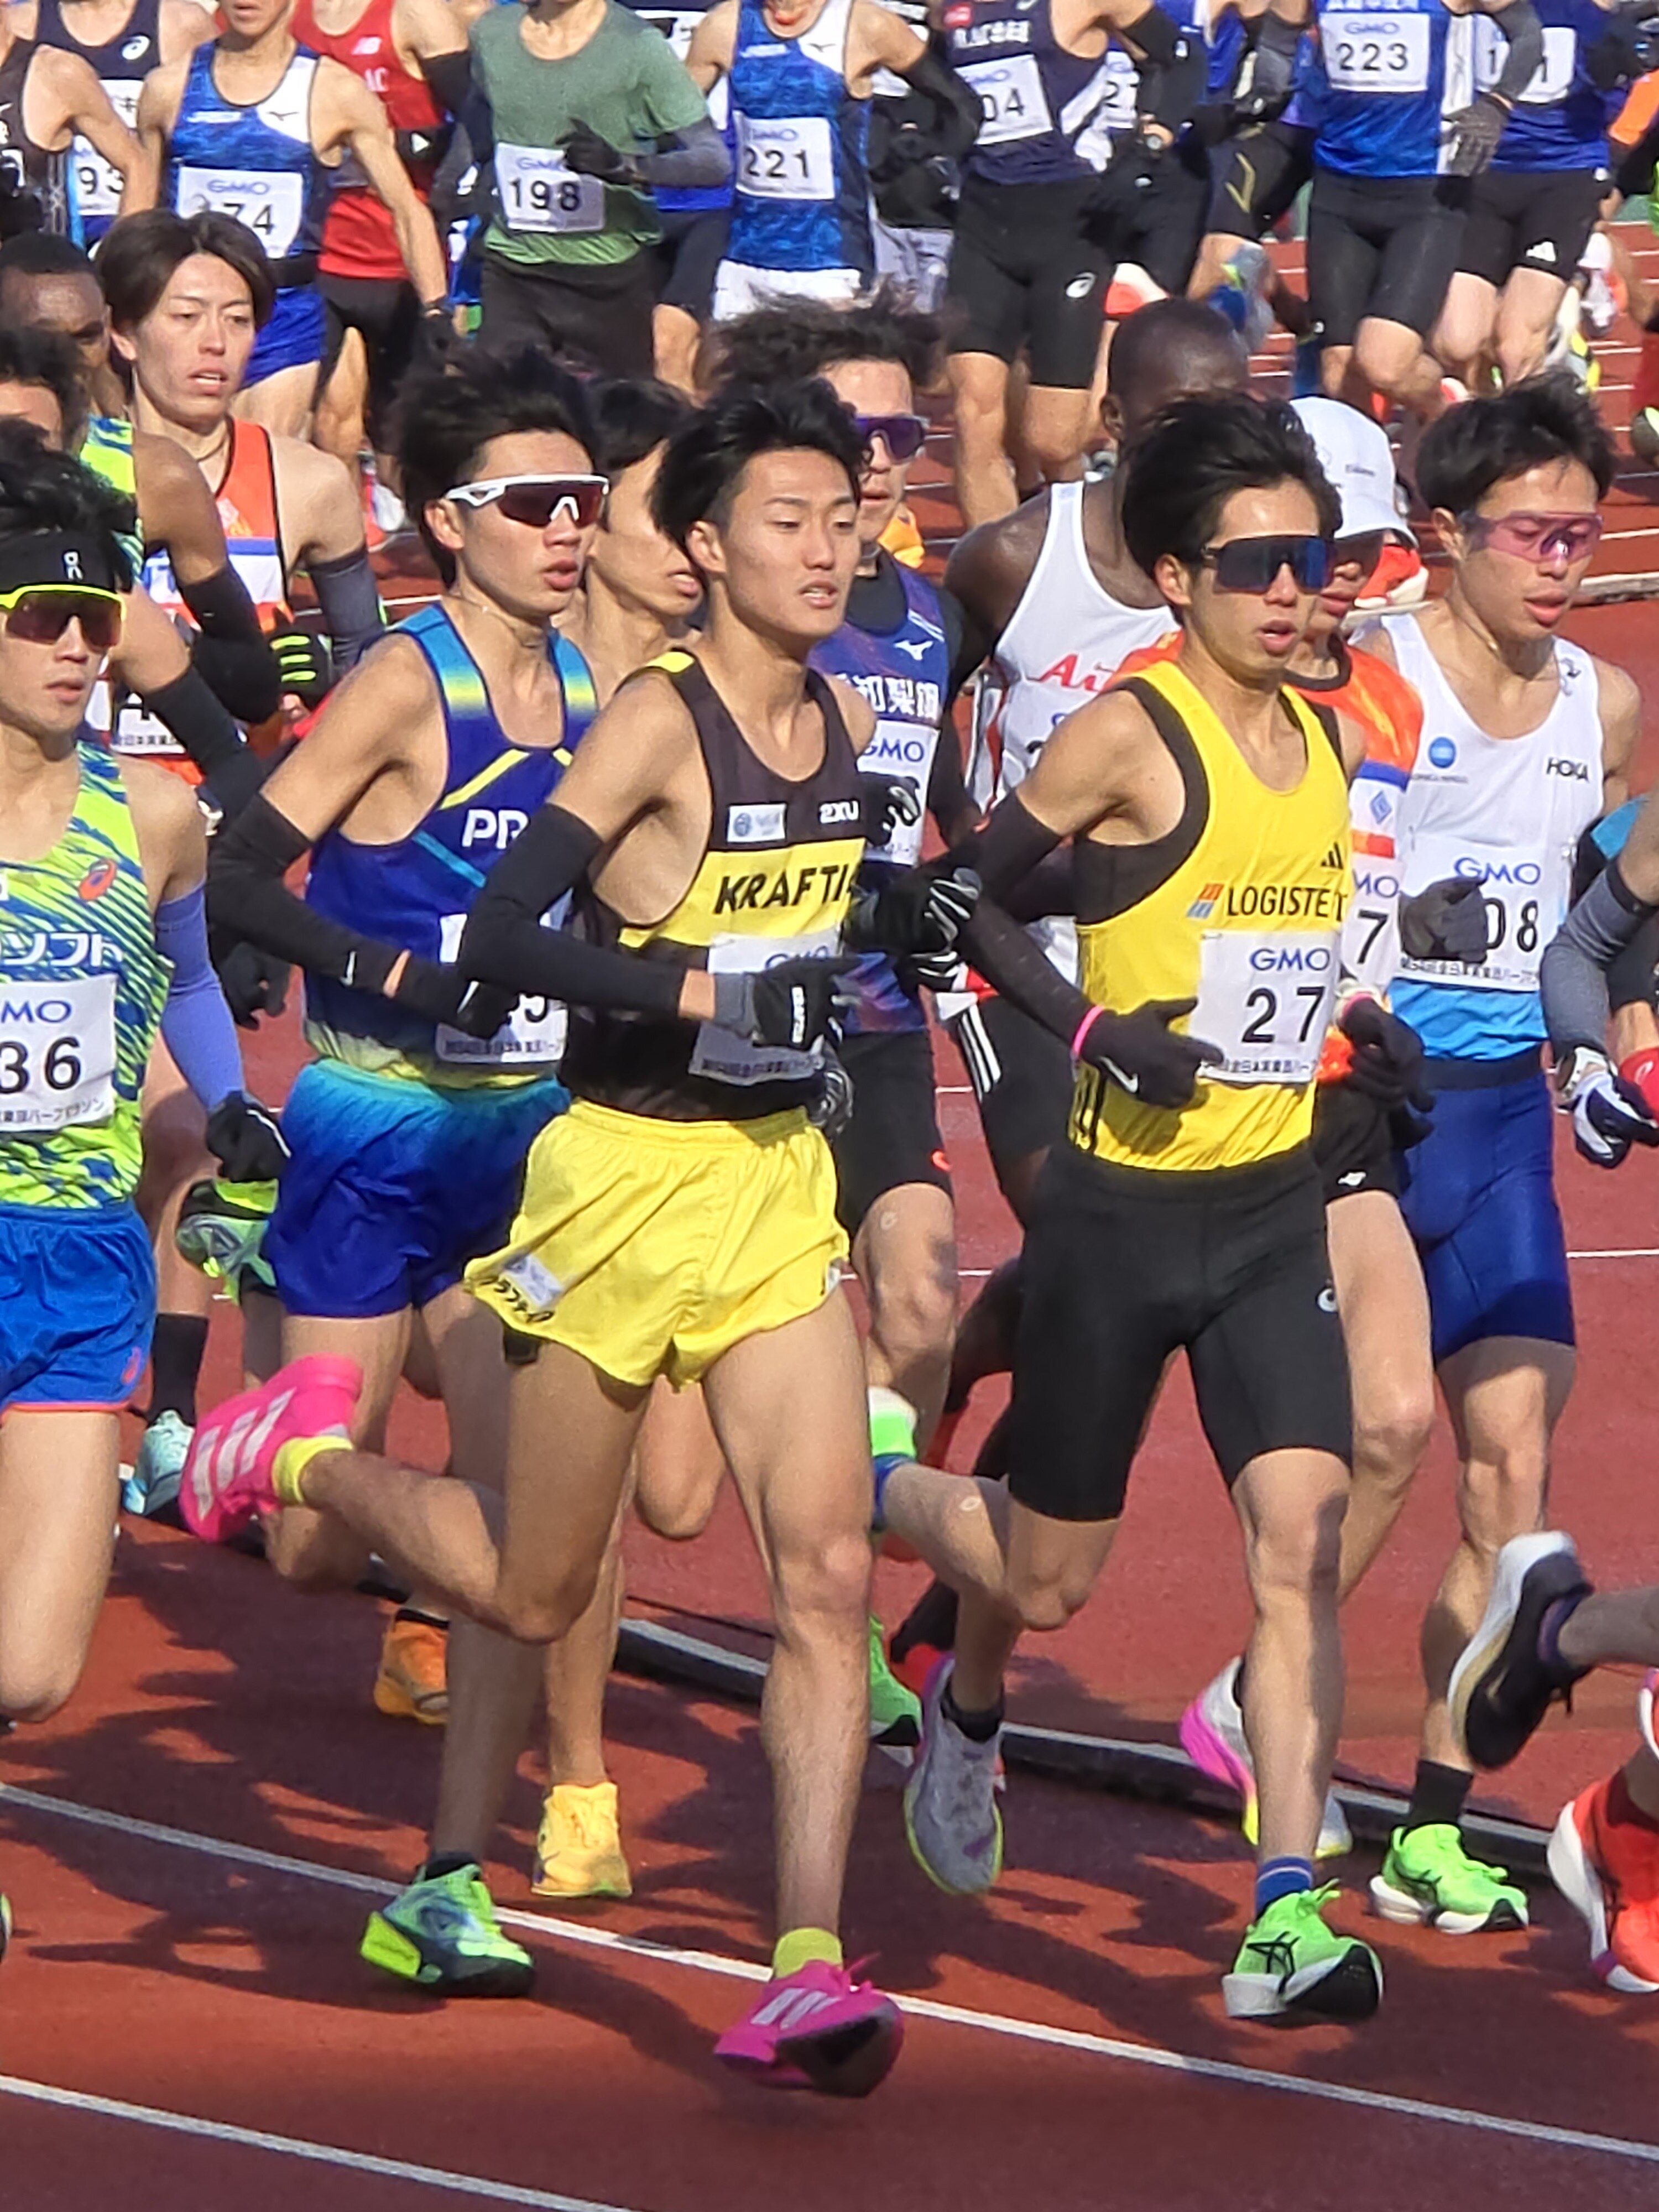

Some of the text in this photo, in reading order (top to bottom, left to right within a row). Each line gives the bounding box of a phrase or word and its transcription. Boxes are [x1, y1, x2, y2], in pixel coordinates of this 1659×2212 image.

[1336, 43, 1408, 71] 223
[744, 147, 808, 177] 221
[508, 178, 581, 211] 198
[1547, 757, 1589, 783] HOKA
[820, 801, 859, 823] 2XU
[1454, 857, 1541, 885] GMO
[713, 863, 853, 915] KRAFTI
[1358, 909, 1389, 964] 7
[1249, 948, 1330, 971] GMO
[1, 1000, 72, 1023] MO
[1241, 986, 1325, 1043] 27
[0, 1036, 81, 1094] 36
